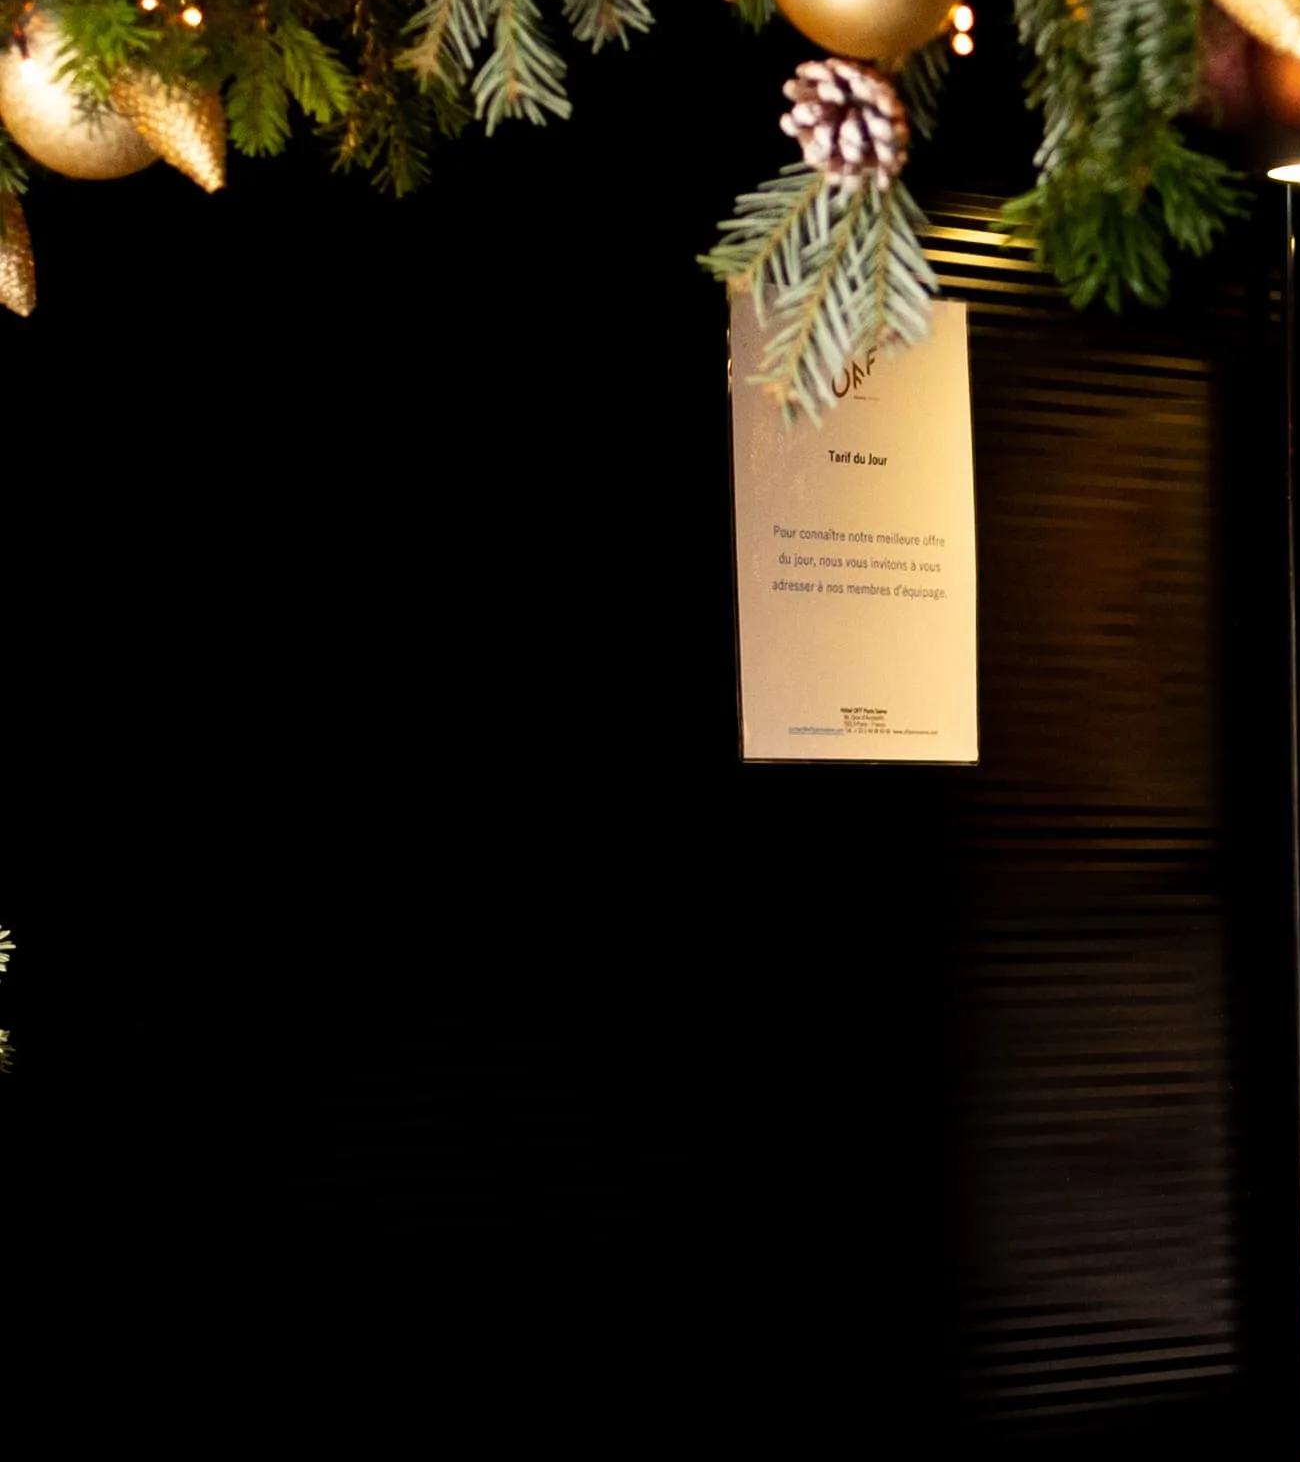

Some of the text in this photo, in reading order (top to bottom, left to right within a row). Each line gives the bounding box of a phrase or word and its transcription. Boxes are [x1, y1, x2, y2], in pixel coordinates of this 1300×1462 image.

[828, 450, 887, 466] Tarif du Jour
[773, 525, 945, 547] Pour connaître notre meilleure offre
[778, 552, 791, 565] du
[794, 553, 816, 568] jour,
[820, 556, 842, 568] nous
[846, 558, 868, 568] vous
[870, 558, 908, 570] invitons
[920, 562, 942, 572] vous
[772, 579, 814, 592] adresser
[817, 580, 823, 592] à
[826, 584, 844, 594] nos
[846, 583, 890, 596] membres
